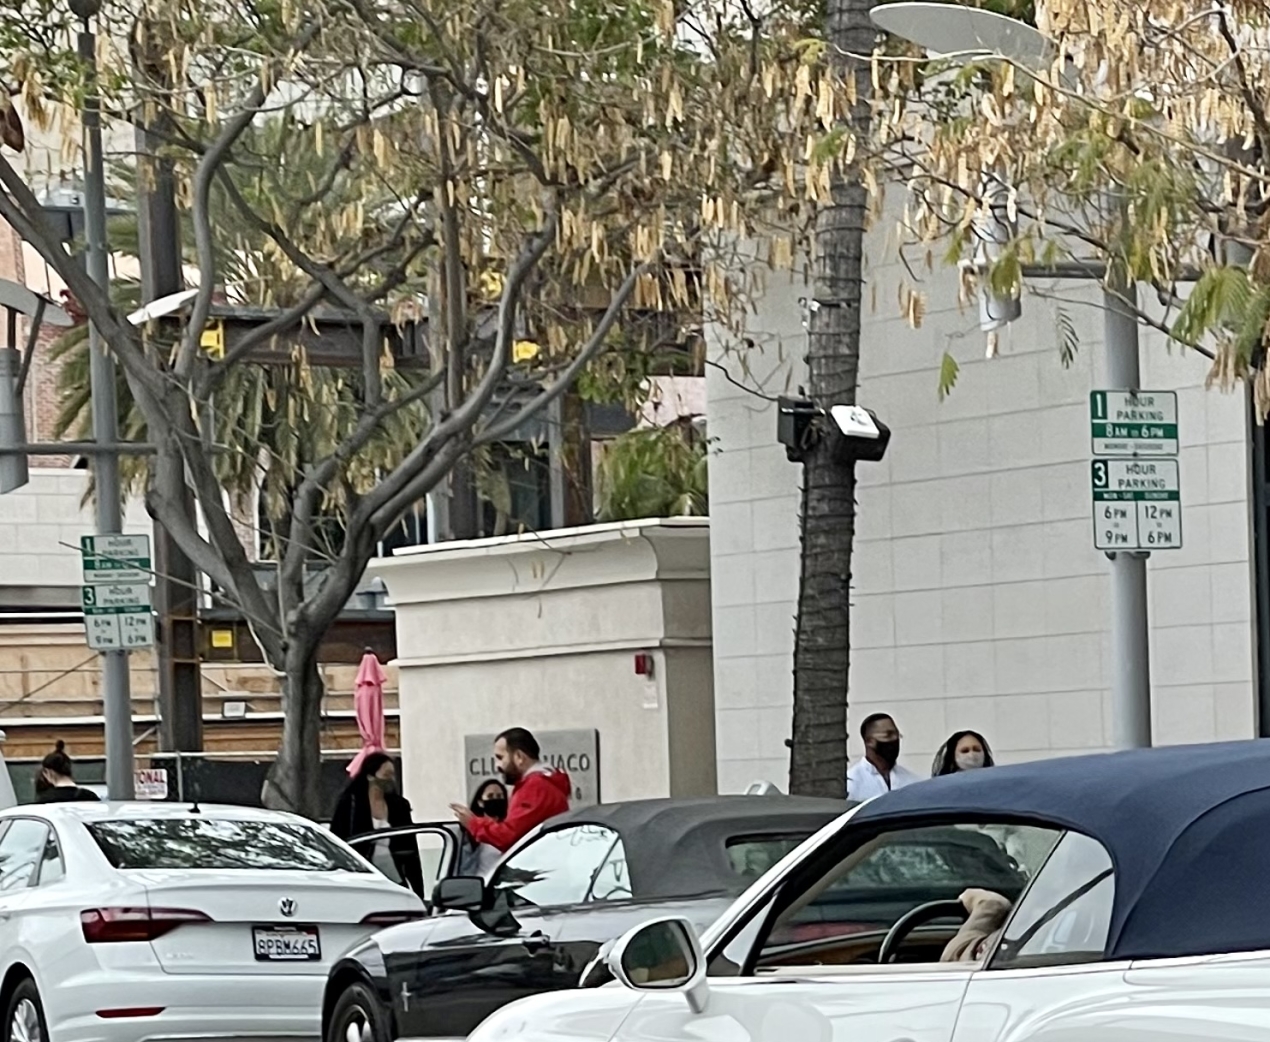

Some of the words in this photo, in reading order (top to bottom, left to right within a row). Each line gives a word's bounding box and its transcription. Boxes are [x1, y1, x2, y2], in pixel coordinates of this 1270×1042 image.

[1096, 393, 1103, 418] 1
[1124, 397, 1155, 407] HOUR
[1116, 410, 1164, 421] PARKING
[1094, 462, 1106, 486] 3
[1125, 463, 1156, 475] HOUR
[1118, 479, 1166, 489] PARKING
[84, 587, 94, 604] 3
[469, 757, 499, 776] CLU
